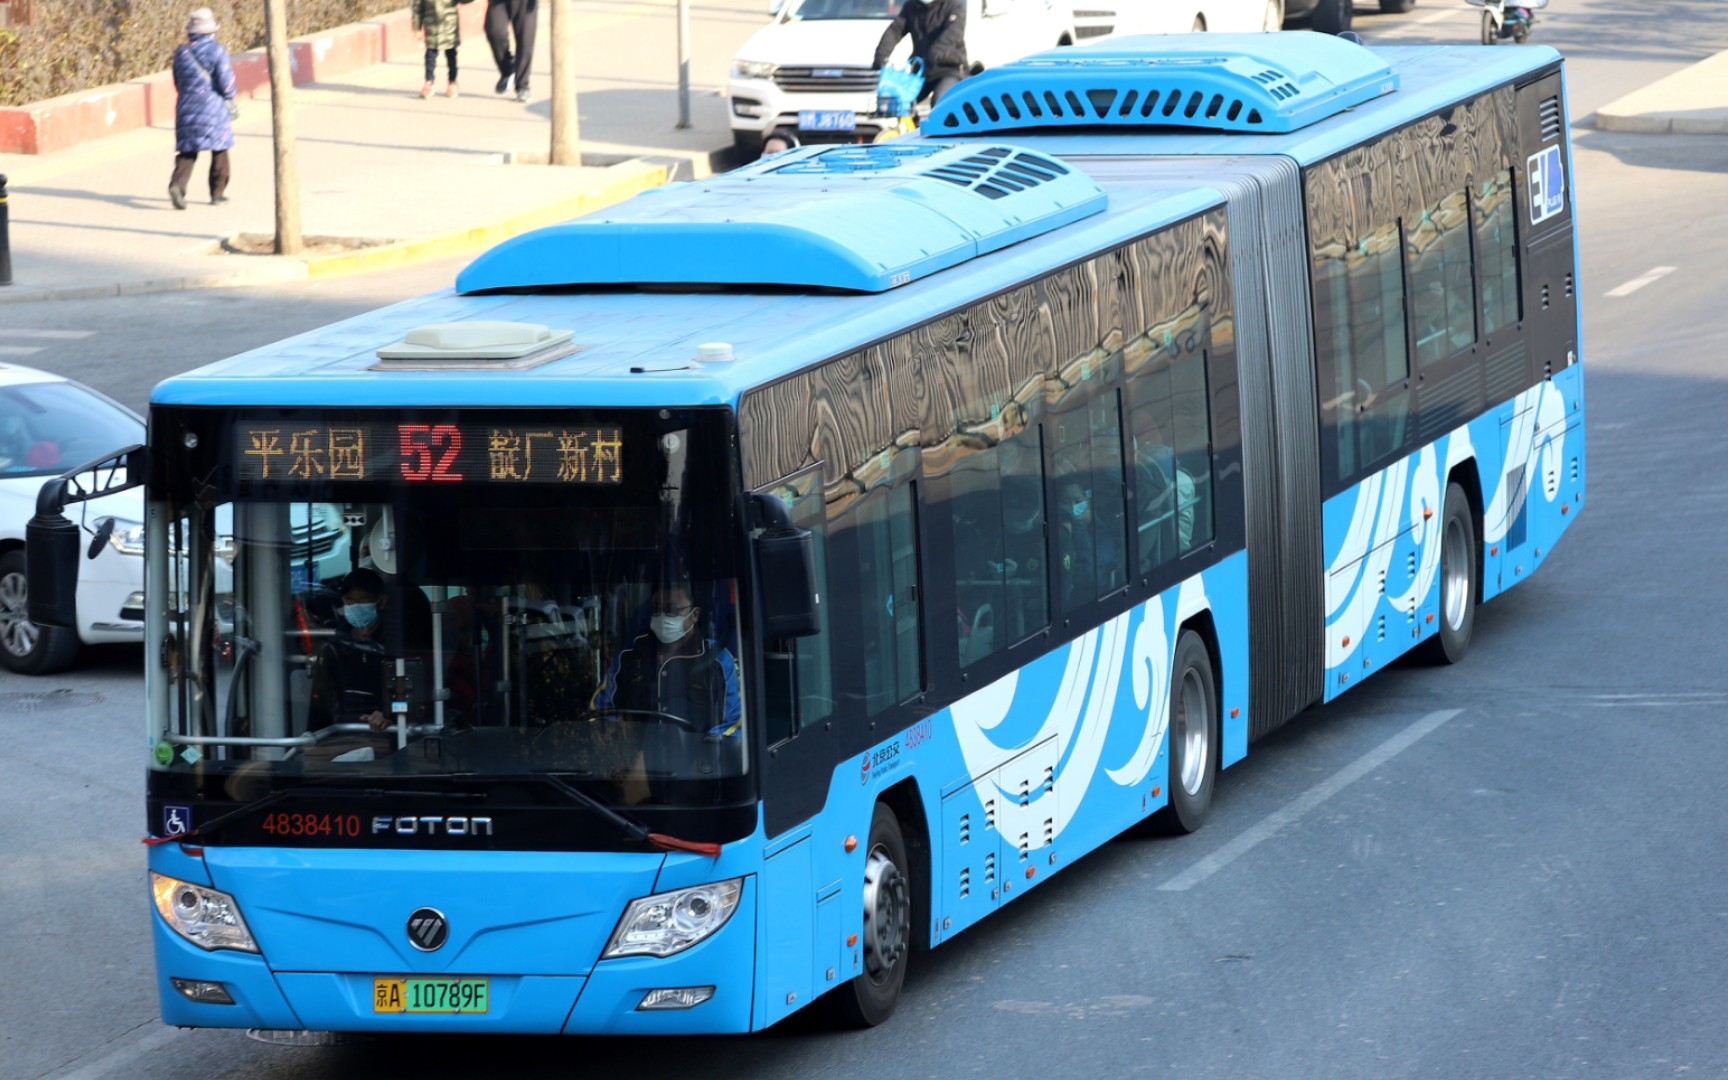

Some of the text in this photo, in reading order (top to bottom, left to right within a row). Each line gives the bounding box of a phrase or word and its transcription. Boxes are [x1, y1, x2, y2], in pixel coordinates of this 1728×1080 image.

[244, 428, 365, 479] 平乐园
[398, 424, 463, 481] 52
[872, 741, 900, 767] 北京公交
[262, 813, 494, 837] 4838410 FOTON
[376, 983, 486, 1008] 京A 10789F
